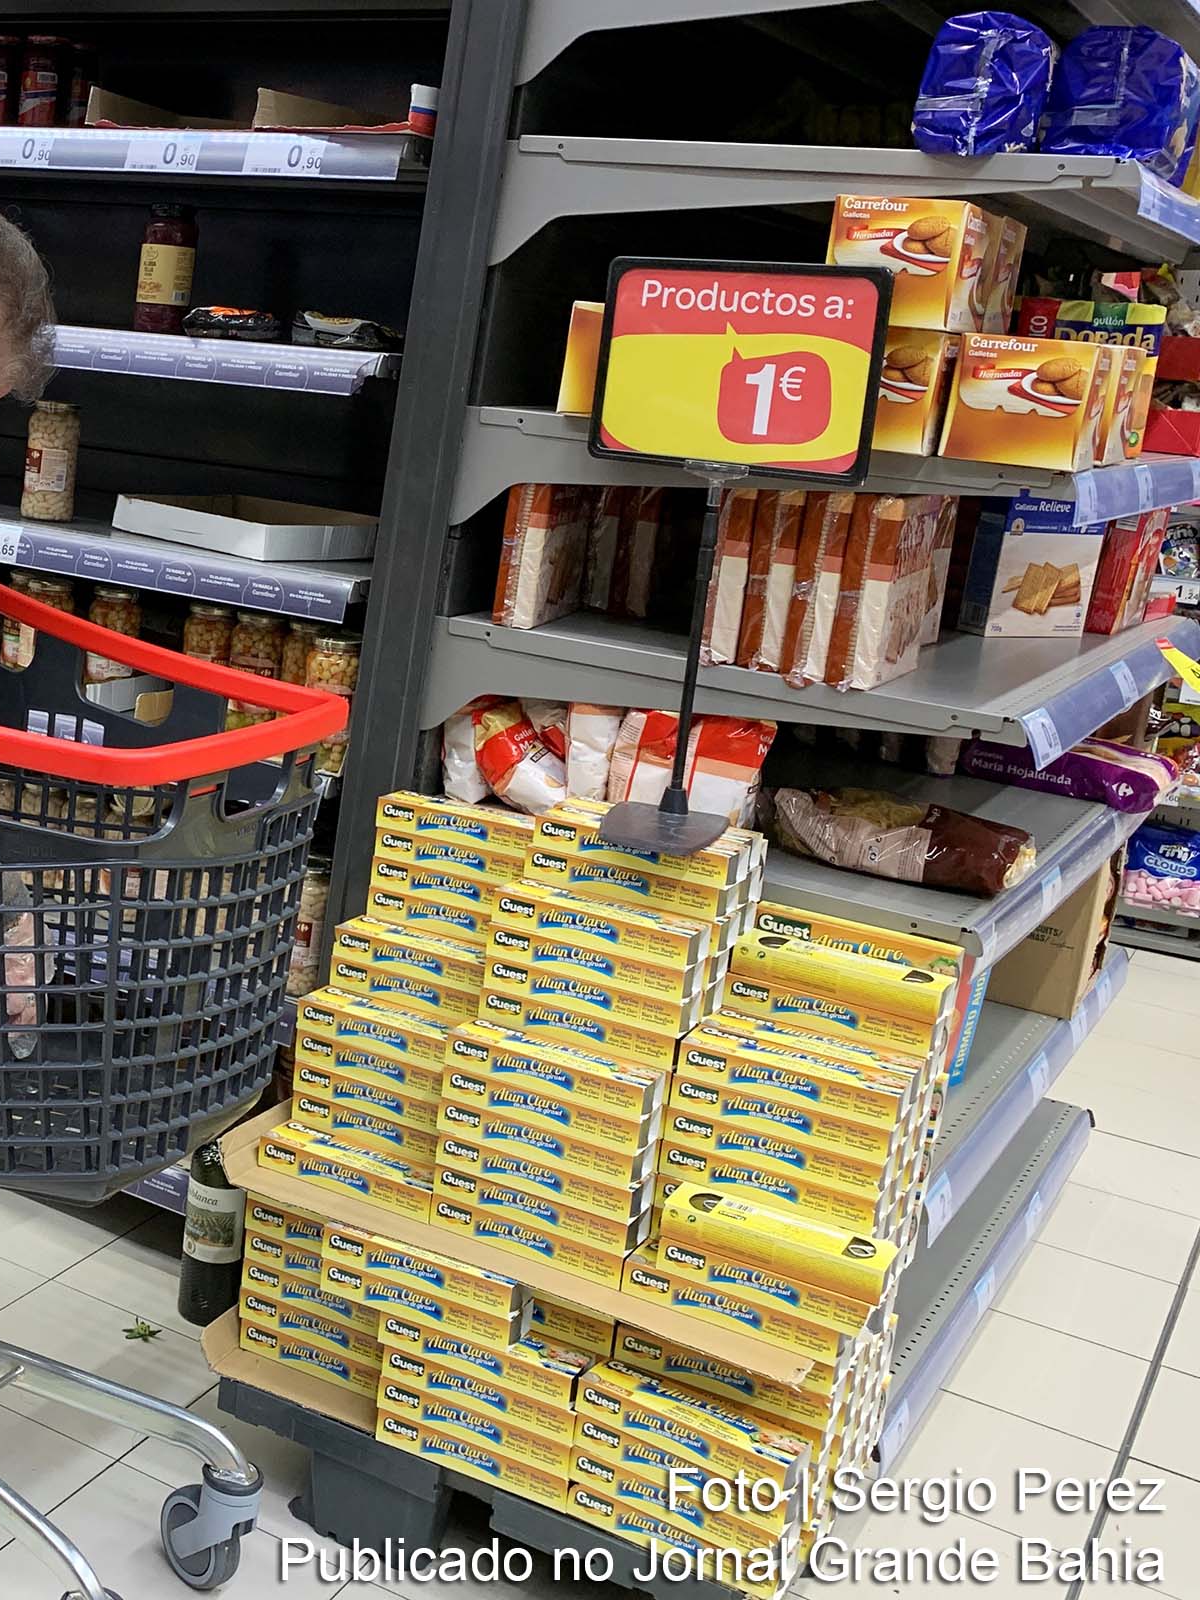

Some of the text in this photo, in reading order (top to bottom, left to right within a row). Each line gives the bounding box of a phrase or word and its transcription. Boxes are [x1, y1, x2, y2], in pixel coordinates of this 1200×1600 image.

[844, 197, 909, 213] Carrefour
[852, 229, 894, 240] Horneadas
[641, 279, 855, 320] Productos a:
[969, 337, 1039, 353] Carrefour
[978, 369, 1023, 380] Horneadas
[745, 363, 807, 436] 1€
[1039, 500, 1071, 513] Relieve
[1007, 763, 1073, 785] Hojaldrada
[384, 805, 414, 820] Guest
[542, 822, 576, 840] Guest
[382, 835, 412, 850] Guest
[378, 864, 407, 880] Guest
[532, 854, 567, 872] Guest
[1144, 855, 1197, 877] CLOUDS
[375, 893, 404, 909] Guest
[501, 898, 534, 916] Guest
[759, 914, 810, 940] Guest
[341, 935, 370, 950] Guest
[494, 932, 529, 949] Guest
[571, 948, 603, 961] Claro
[858, 941, 903, 960] Claro
[338, 964, 367, 980] Guest
[493, 964, 528, 982] Guest
[569, 980, 601, 994] Claro
[732, 982, 769, 1001] Guest
[487, 995, 521, 1012] Guest
[813, 999, 847, 1013] Claro
[304, 1007, 334, 1024] Guest
[302, 1038, 332, 1054] Guest
[454, 1041, 488, 1059] Guest
[952, 1009, 978, 1077] FORMATO
[688, 1051, 726, 1069] Guest
[300, 1069, 330, 1085] Guest
[452, 1074, 486, 1092] Guest
[772, 1070, 808, 1085] Claro
[681, 1083, 718, 1101] Guest
[300, 1098, 329, 1115] Guest
[527, 1094, 559, 1109] Claro
[766, 1101, 800, 1117] Claro
[446, 1106, 480, 1125] Guest
[674, 1117, 712, 1136] Guest
[445, 1140, 479, 1158] Guest
[759, 1136, 792, 1151] Claro
[266, 1145, 295, 1163] Guest
[670, 1150, 706, 1169] Guest
[441, 1171, 476, 1190] Guest
[752, 1170, 786, 1186] Claro
[253, 1208, 283, 1227] Guest
[438, 1202, 471, 1222] Guest
[252, 1238, 282, 1257] Guest
[330, 1236, 363, 1256] Guest
[668, 1247, 704, 1266] Guest
[249, 1267, 279, 1286] Guest
[328, 1267, 362, 1287] Guest
[631, 1270, 669, 1290] Guest
[752, 1269, 787, 1287] Claro
[248, 1298, 276, 1317] Guest
[714, 1295, 750, 1311] Claro
[247, 1328, 277, 1347] Guest
[387, 1320, 420, 1340] Guest
[624, 1338, 662, 1358] Guest
[391, 1354, 424, 1376] Guest
[386, 1387, 420, 1408] Guest
[585, 1388, 620, 1411] Guest
[385, 1419, 418, 1440] Guest
[583, 1422, 620, 1446] Guest
[662, 1420, 697, 1439] Claro
[578, 1457, 614, 1480] Guest
[576, 1490, 612, 1516] Guest
[656, 1523, 691, 1541] Claro
